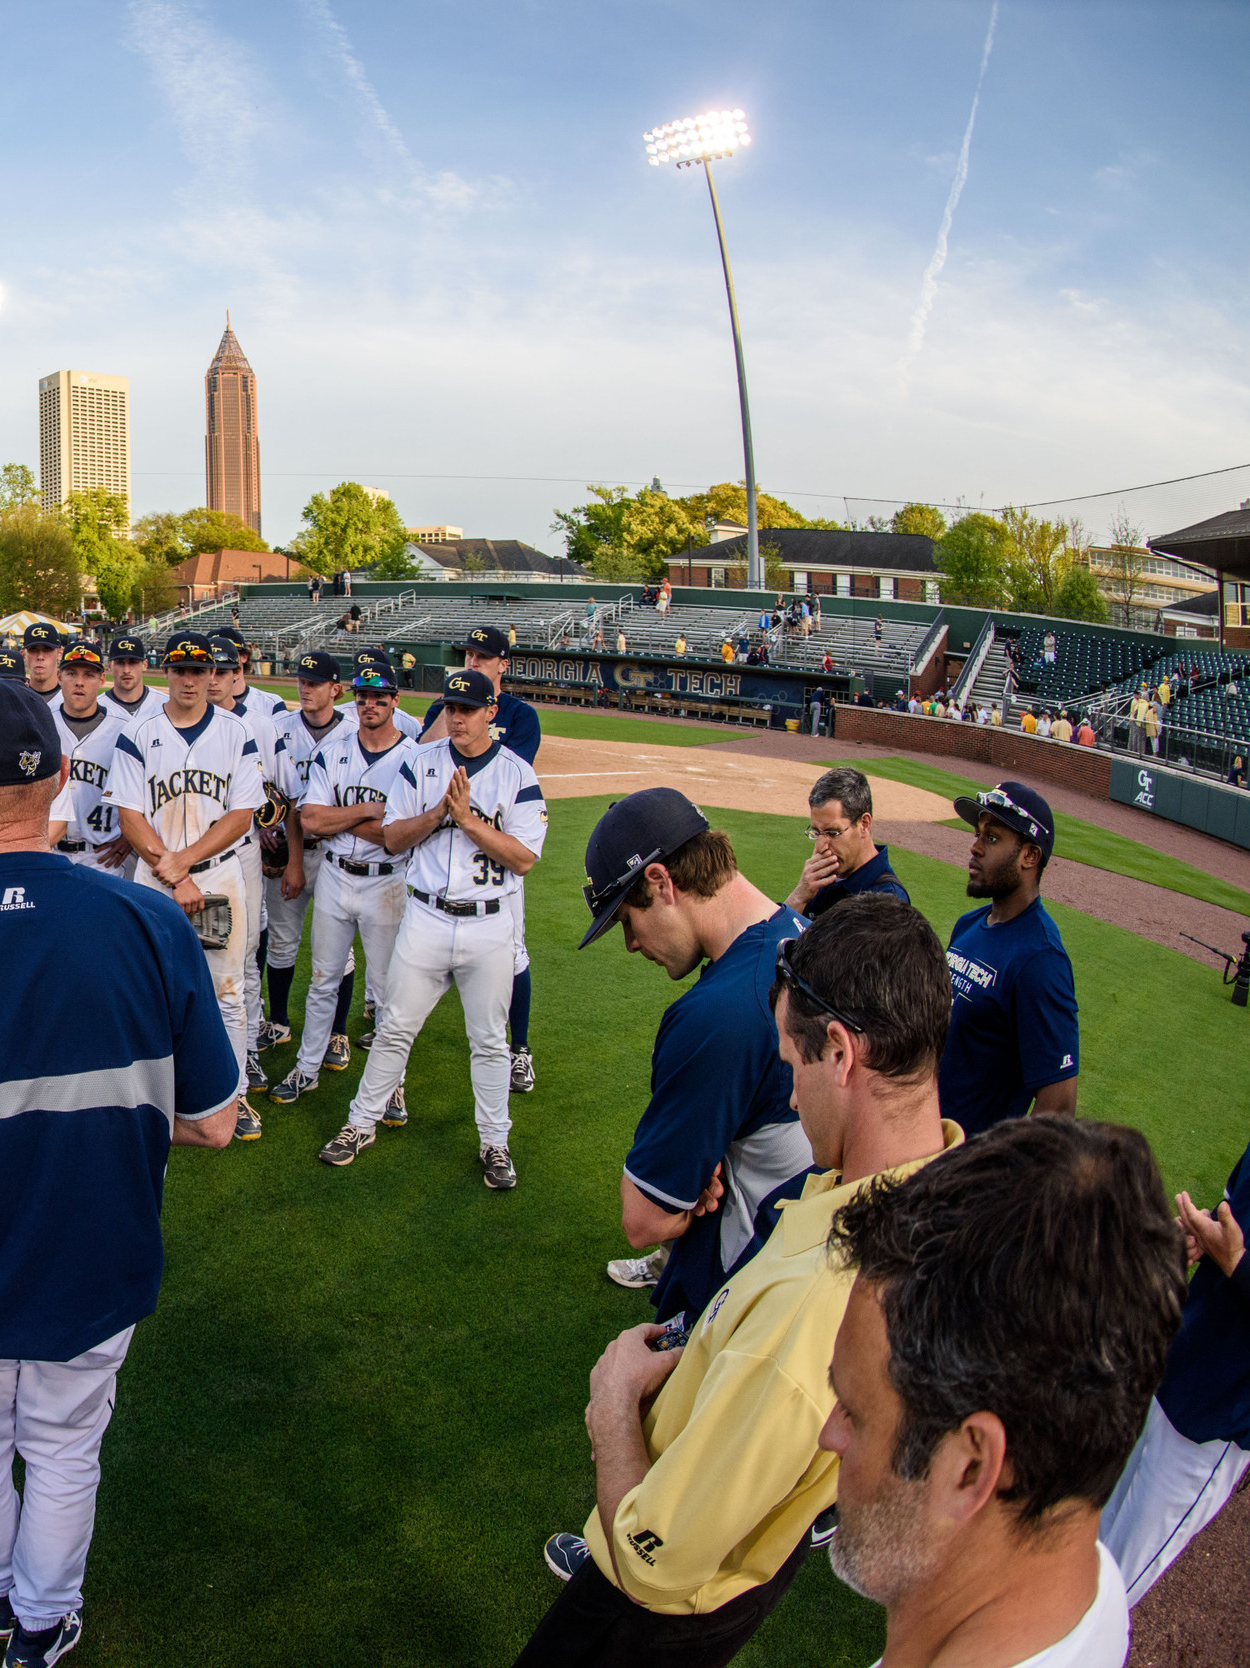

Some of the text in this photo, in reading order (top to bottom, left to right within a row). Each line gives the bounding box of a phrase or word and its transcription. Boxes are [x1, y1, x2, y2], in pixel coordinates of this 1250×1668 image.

[31, 627, 49, 639] GT
[471, 629, 488, 642] GT
[117, 640, 136, 651] GT
[301, 656, 318, 669] GT
[449, 676, 470, 692] GT
[614, 661, 654, 690] GT
[666, 668, 742, 696] TECH
[1138, 770, 1153, 791] GT
[1134, 791, 1154, 807] ACC
[86, 805, 113, 832] 41
[472, 853, 505, 886] 39
[967, 962, 993, 988] TECH
[627, 1533, 656, 1567] RUSSELL
